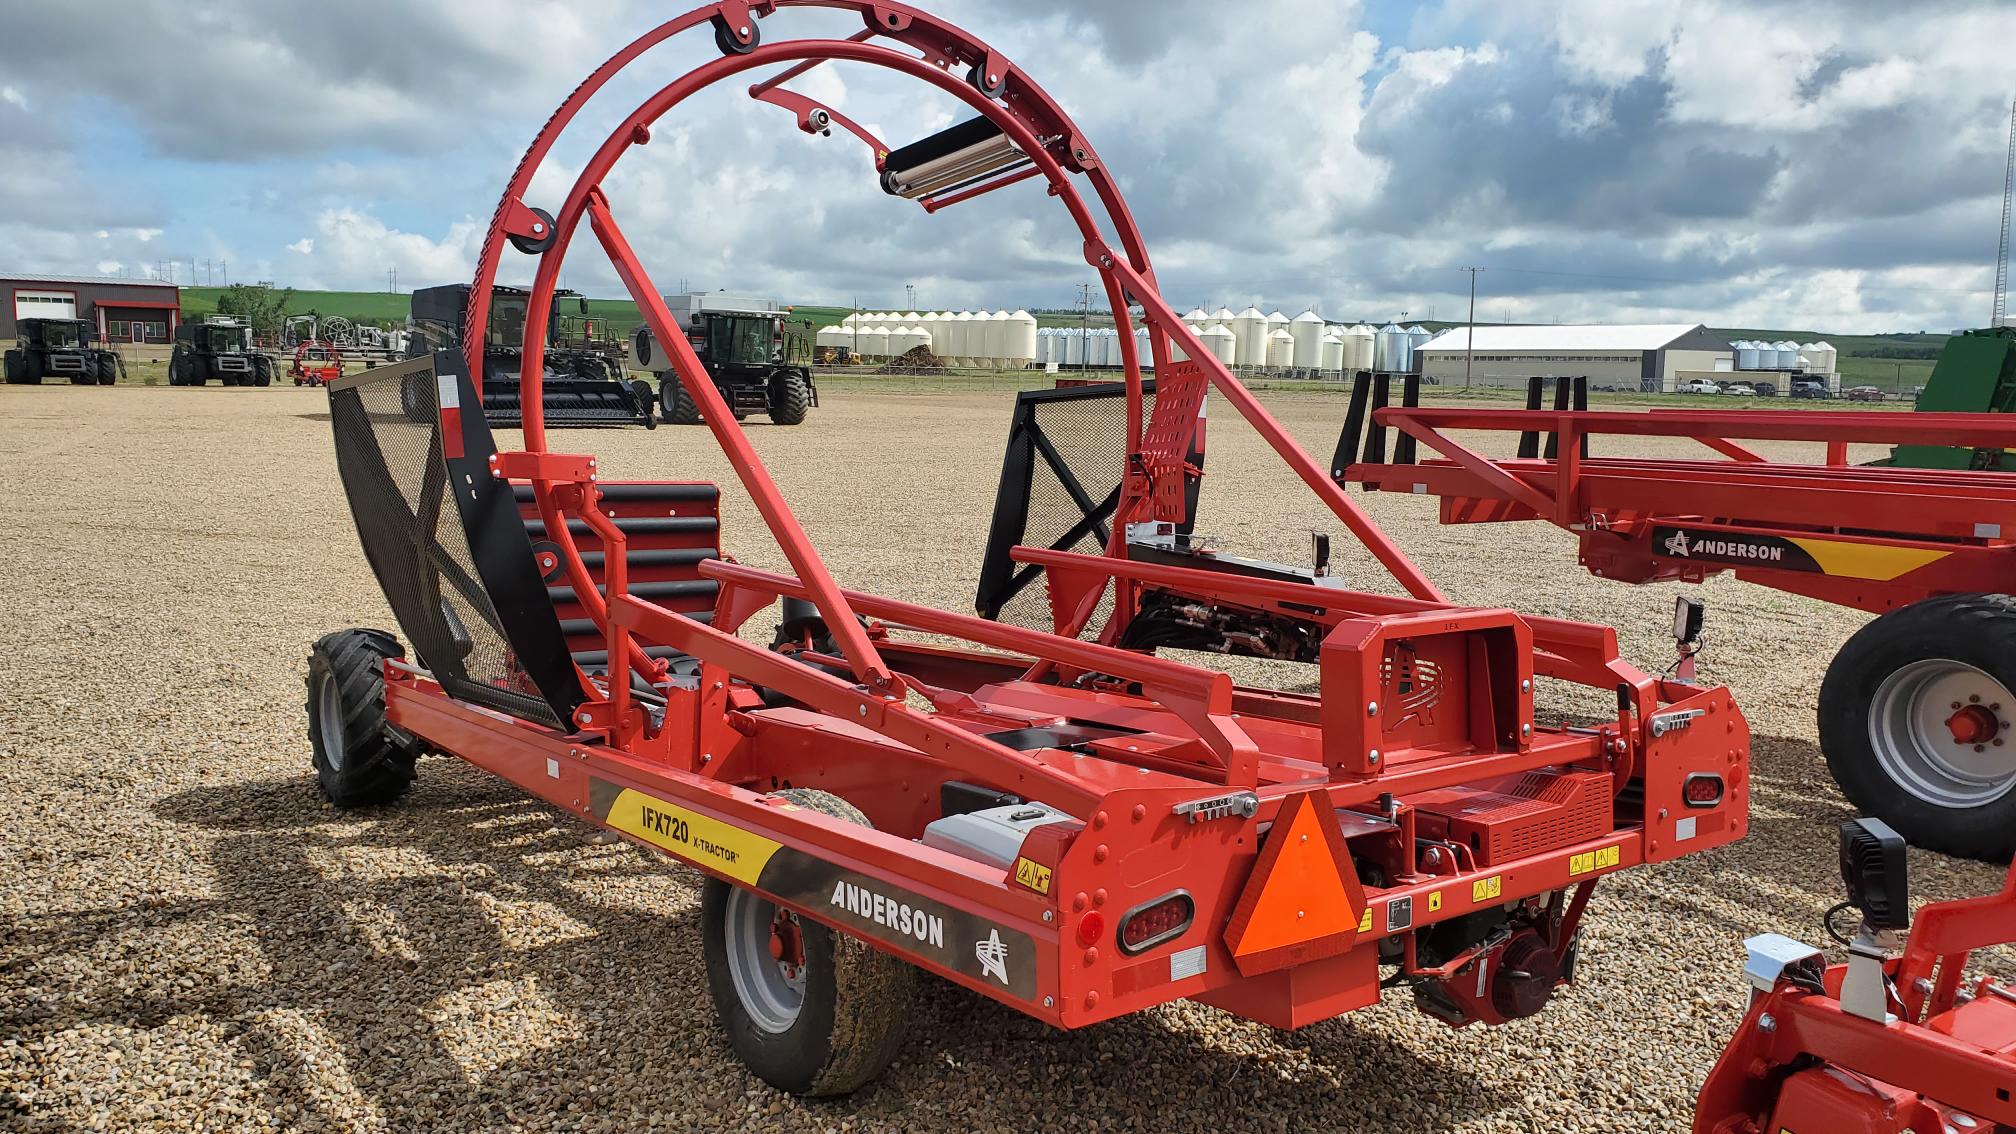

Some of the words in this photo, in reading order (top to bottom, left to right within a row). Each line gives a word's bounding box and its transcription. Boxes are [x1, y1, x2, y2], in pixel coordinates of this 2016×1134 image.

[1692, 540, 1781, 560] ANDERSON
[641, 805, 689, 844] IFX720
[830, 880, 944, 949] ANDERSON
